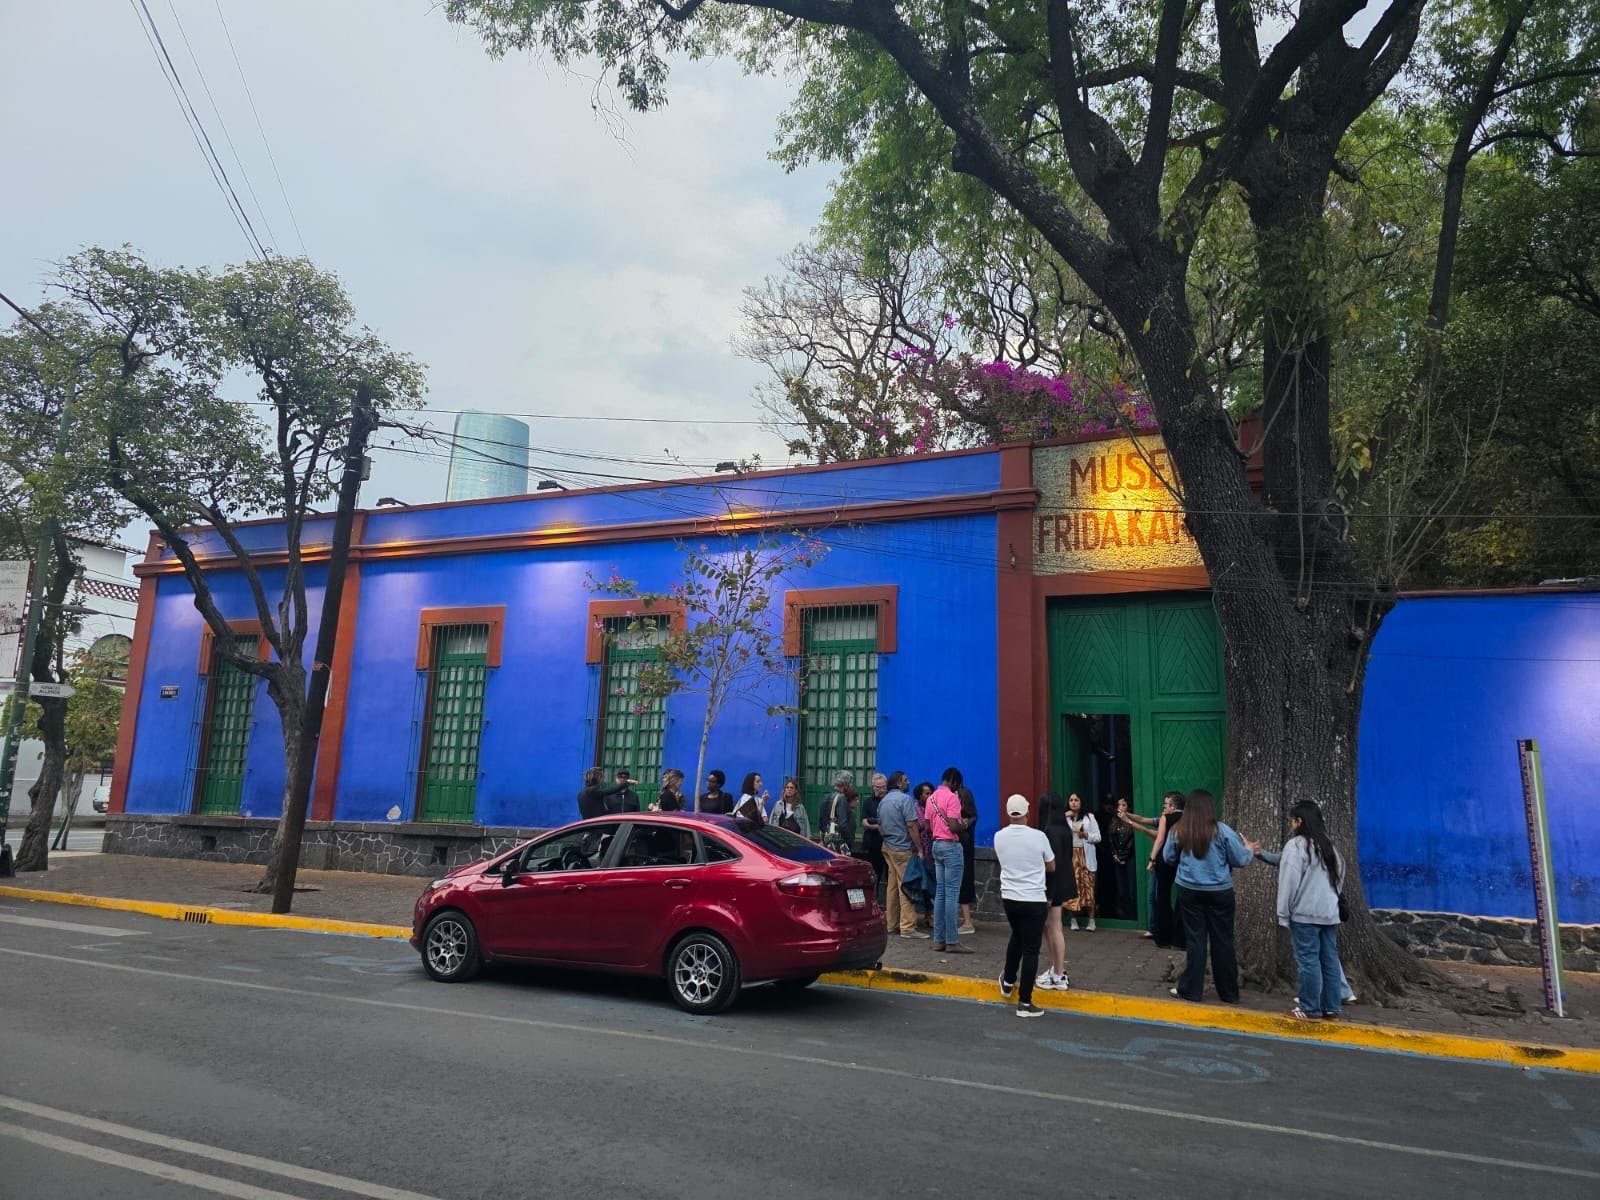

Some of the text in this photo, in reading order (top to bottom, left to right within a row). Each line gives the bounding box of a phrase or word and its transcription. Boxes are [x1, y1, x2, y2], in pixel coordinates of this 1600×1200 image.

[1070, 449, 1181, 496] MUSE
[1038, 504, 1194, 554] FRIDA KAH
